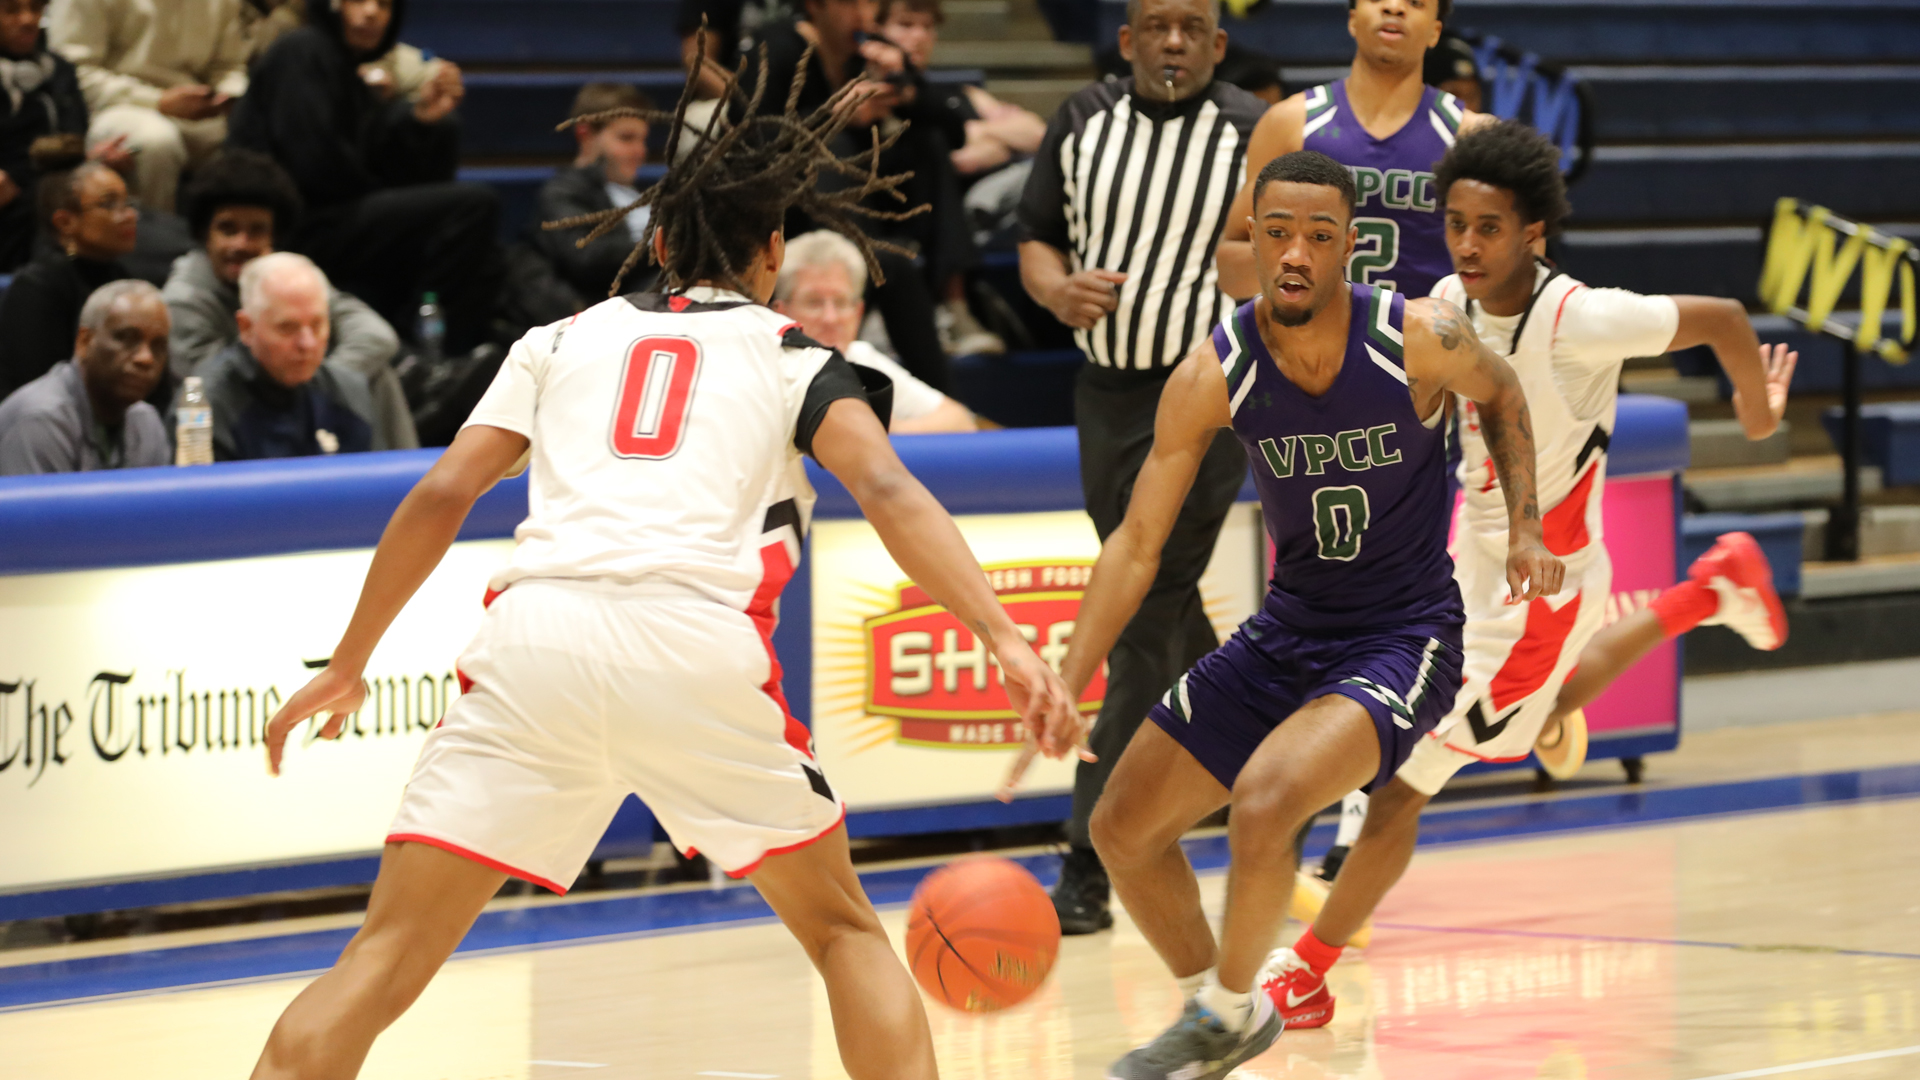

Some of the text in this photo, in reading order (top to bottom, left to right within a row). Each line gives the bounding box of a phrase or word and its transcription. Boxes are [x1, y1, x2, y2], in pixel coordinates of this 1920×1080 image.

[1345, 164, 1437, 213] PCC
[1346, 217, 1399, 294] 2
[607, 334, 703, 461] 0
[1258, 423, 1402, 478] VPCC
[1312, 484, 1370, 562] 0
[984, 567, 1032, 591] ESH
